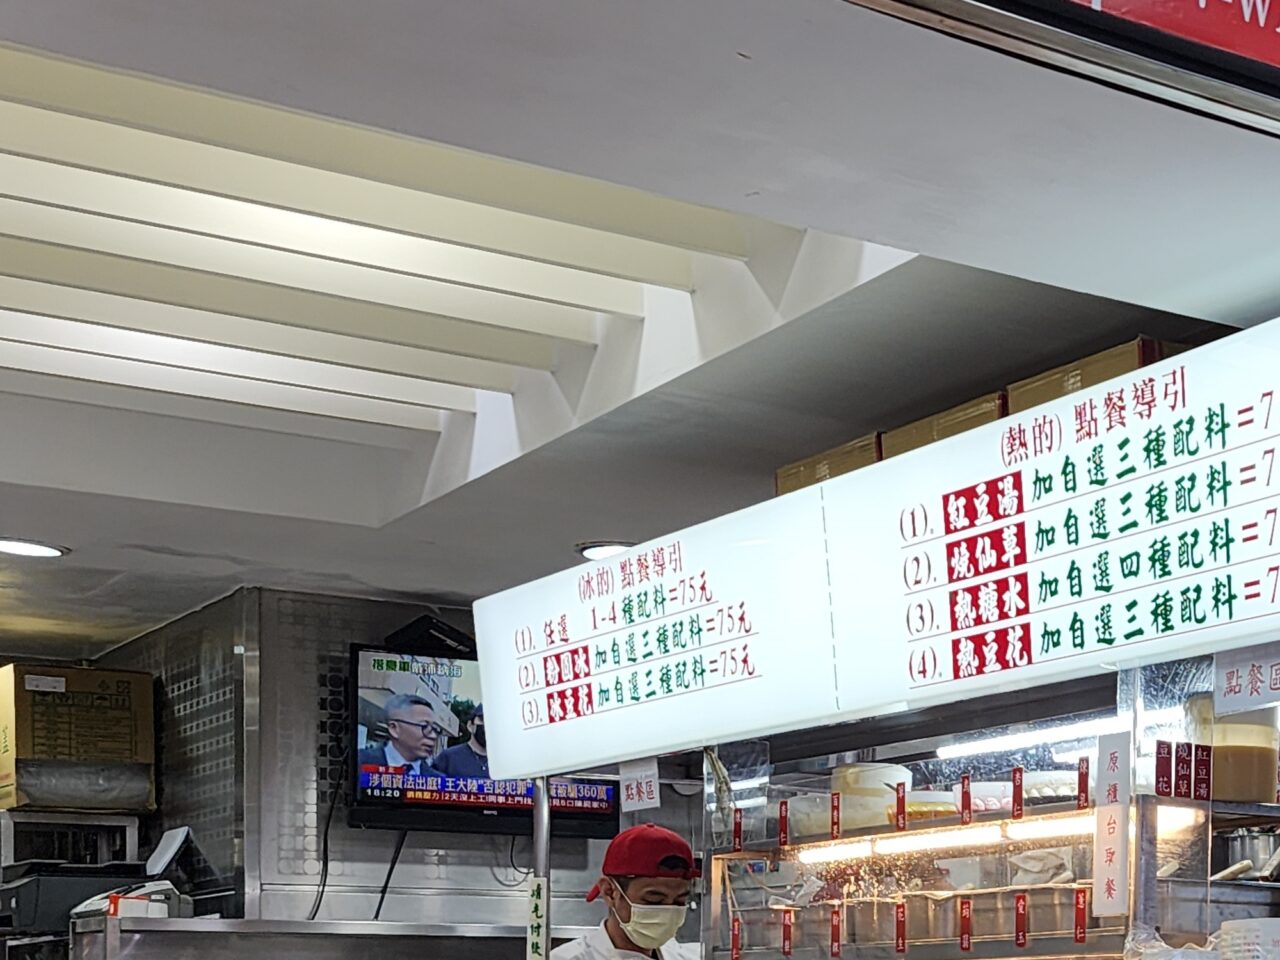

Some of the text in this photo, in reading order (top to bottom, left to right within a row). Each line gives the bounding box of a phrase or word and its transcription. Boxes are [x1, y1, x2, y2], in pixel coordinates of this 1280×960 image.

[1000, 364, 1187, 468] (熱的) 點餐導引
[946, 473, 1021, 531] 紅豆湯
[619, 540, 683, 591] 點餐導引
[952, 574, 1027, 631] 熱糖水
[543, 613, 570, 647] 任選
[955, 626, 1031, 679] 熱豆花
[623, 779, 656, 803] 點餐區
[1157, 743, 1171, 793] 豆花
[1175, 742, 1192, 796] 燒仙草
[1196, 745, 1209, 799] 紅豆湯
[1103, 750, 1120, 900] 原櫃台取餐
